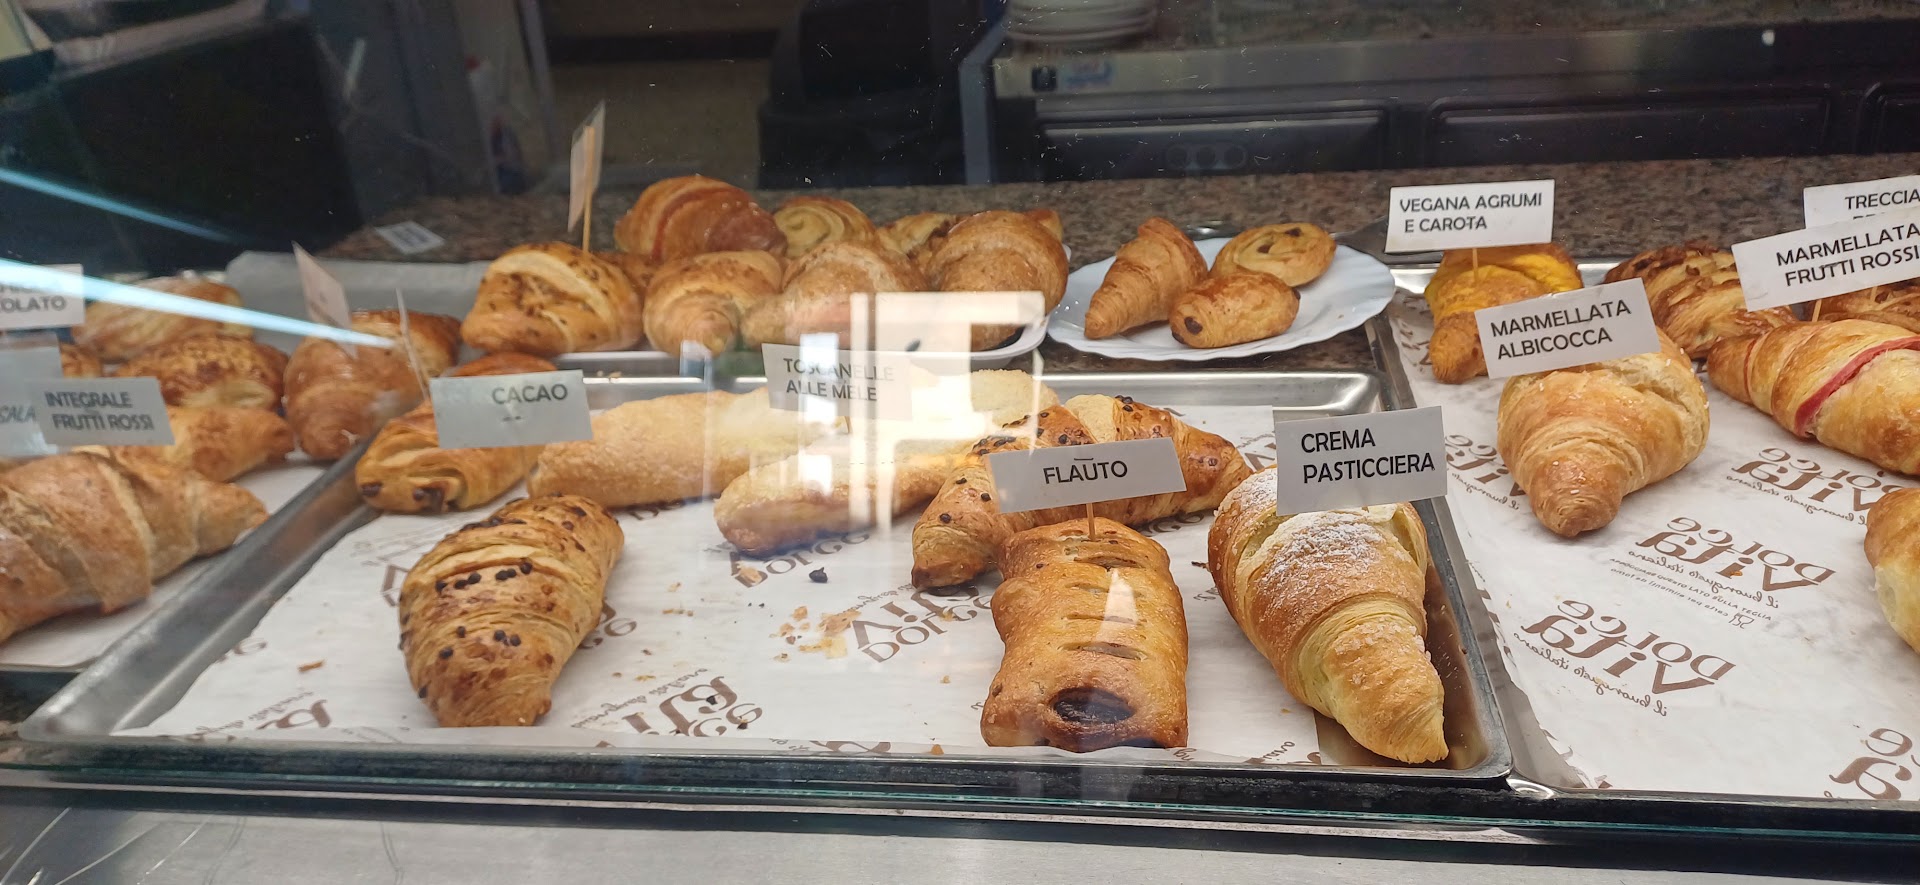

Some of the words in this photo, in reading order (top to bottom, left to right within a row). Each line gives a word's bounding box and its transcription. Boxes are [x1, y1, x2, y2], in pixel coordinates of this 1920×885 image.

[1399, 196, 1470, 213] VEGANA
[1475, 192, 1543, 209] AGRUMI
[1844, 189, 1920, 210] TRECCIA
[1404, 219, 1414, 233] E
[1419, 215, 1488, 232] CAROTA
[1776, 222, 1920, 267] MARMELLATA
[1785, 258, 1855, 287] FRUTTI
[1860, 244, 1920, 271] ROSSI
[1490, 299, 1632, 338] MARMELLATA
[1498, 327, 1613, 360] ALBICOCCA
[44, 391, 133, 409] INTEGRALE
[492, 383, 568, 404] CACAO
[786, 380, 828, 397] ALLE
[832, 384, 878, 402] MELE
[52, 413, 106, 431] FRUTTI
[109, 414, 155, 431] ROSSI
[1301, 427, 1376, 453] CREMA
[1043, 460, 1128, 484] FLAUTO
[1303, 452, 1436, 484] PASTICCIERA
